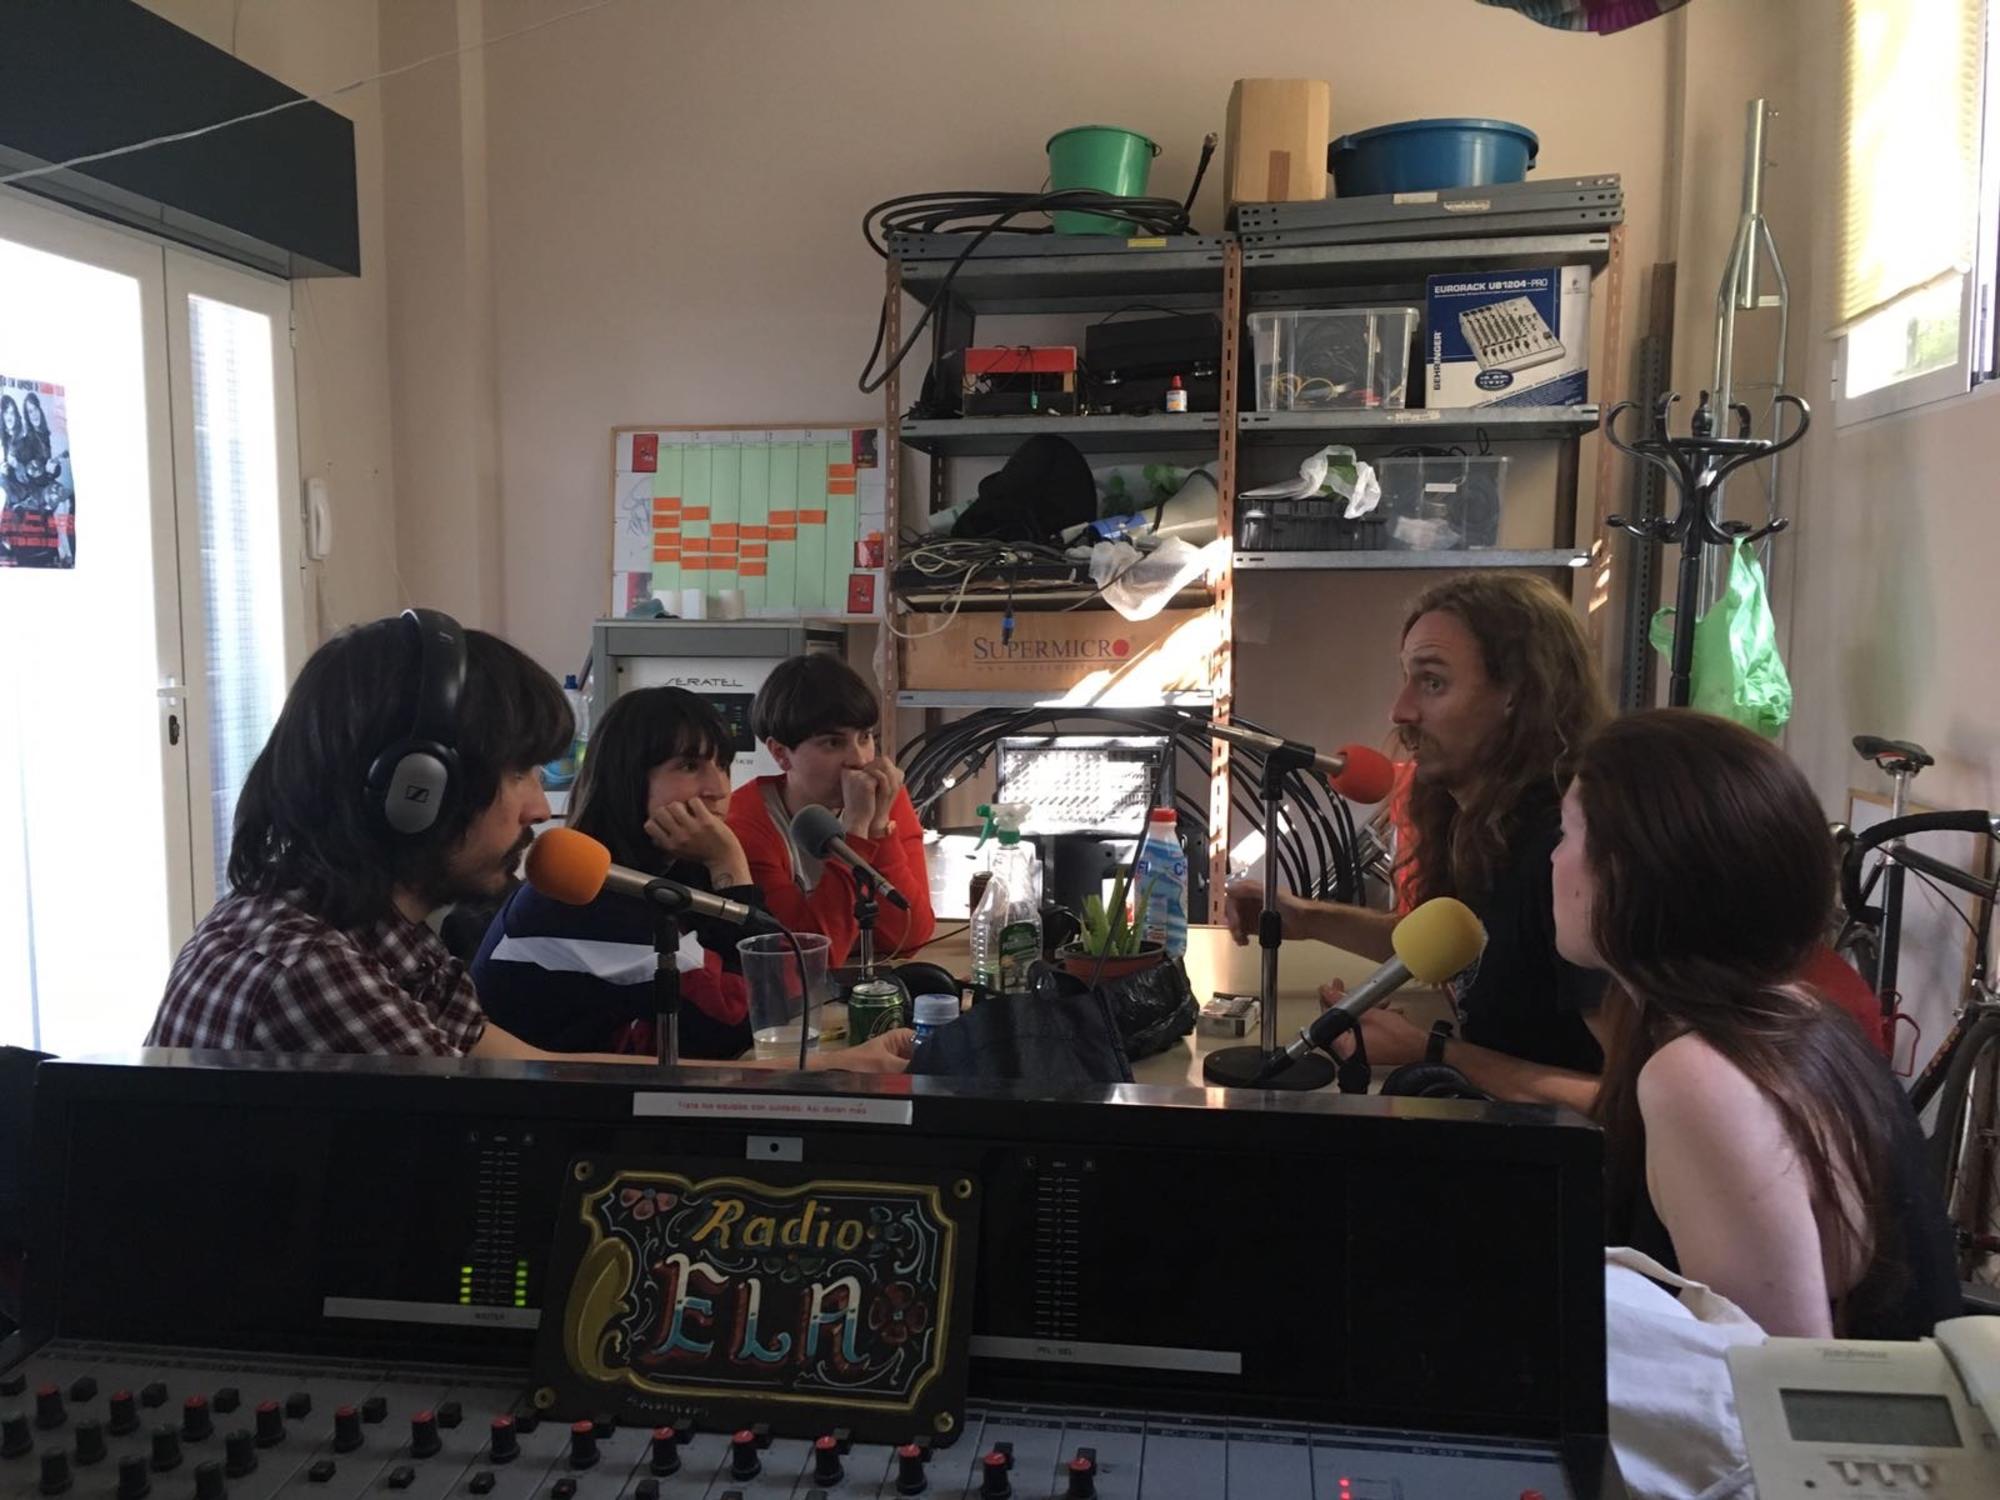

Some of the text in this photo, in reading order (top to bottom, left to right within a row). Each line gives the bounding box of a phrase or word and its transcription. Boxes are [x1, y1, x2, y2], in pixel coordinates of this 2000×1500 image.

[1434, 282, 1486, 294] EURORACK
[1433, 331, 1442, 390] BEHRINGER
[691, 1198, 865, 1251] Radio
[645, 1252, 870, 1372] ELA
